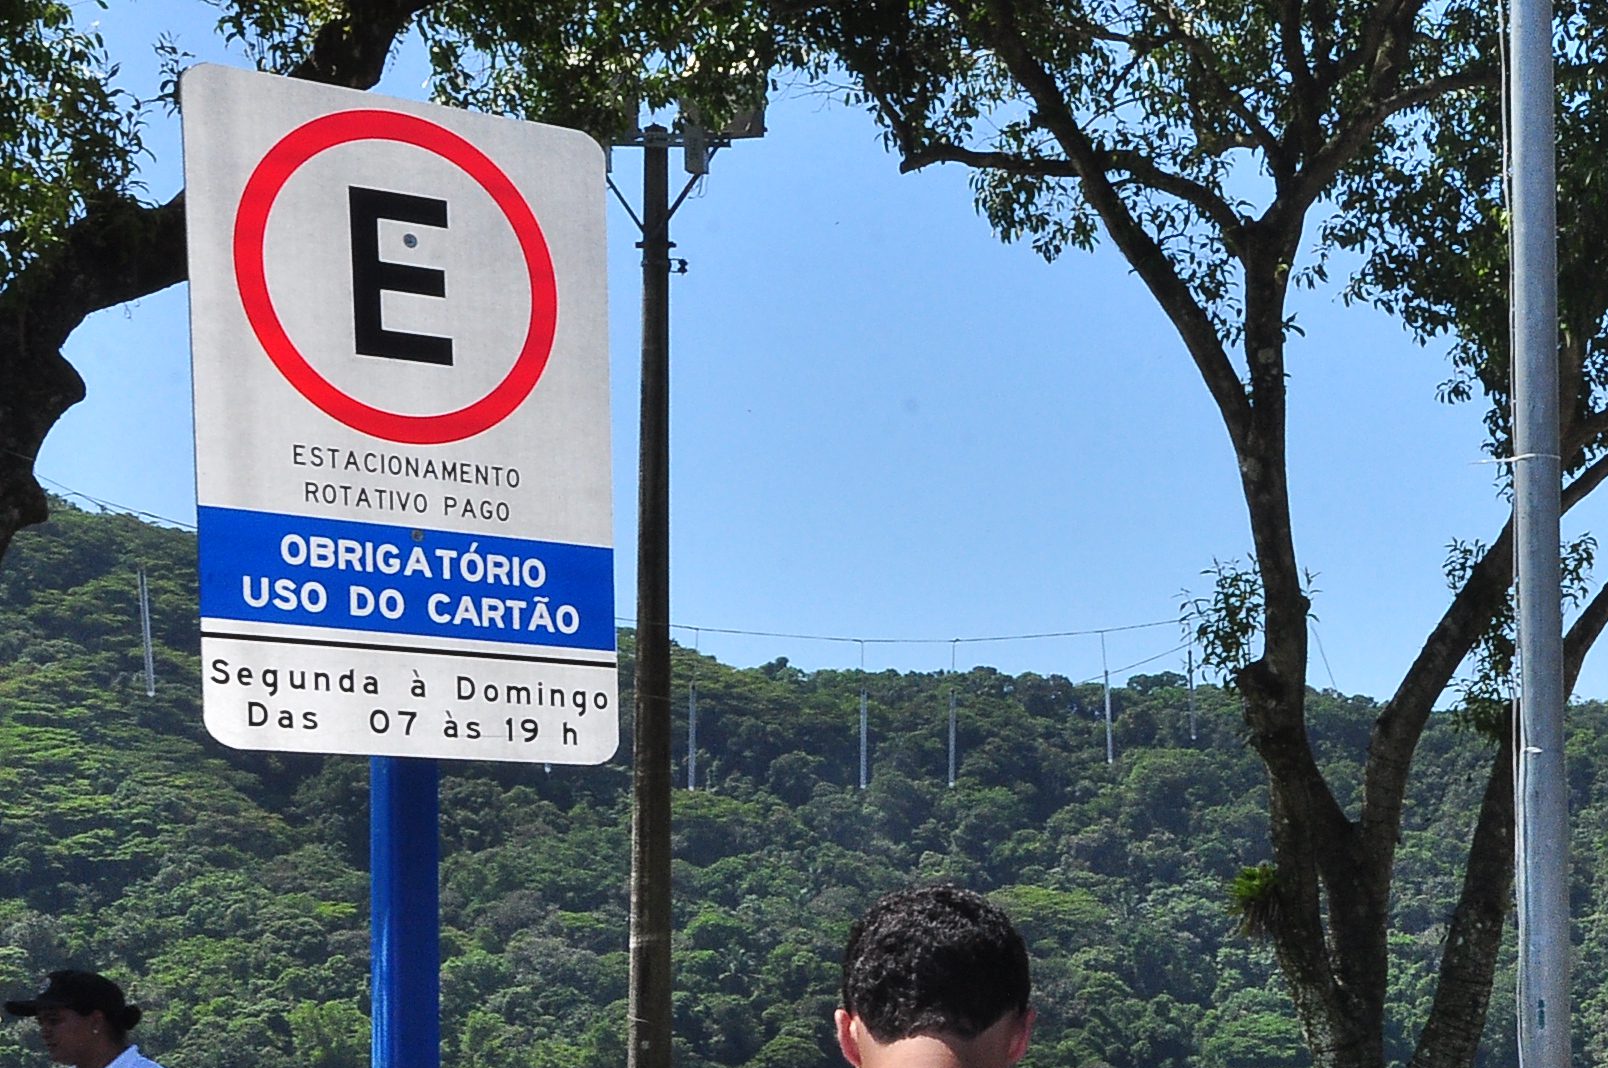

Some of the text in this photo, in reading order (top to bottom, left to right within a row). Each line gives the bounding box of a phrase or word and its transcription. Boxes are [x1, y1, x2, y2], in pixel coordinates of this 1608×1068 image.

[348, 185, 454, 367] E
[292, 444, 521, 489] ESTACIONAMENTO
[304, 481, 511, 522] ROTATIVO PAGO
[280, 533, 547, 589] OBRIGATÓRIO
[241, 575, 580, 635] USO DO CARTÃO
[210, 658, 609, 717] Segunda à Domingo
[247, 701, 578, 746] Das 07 às 19 h
